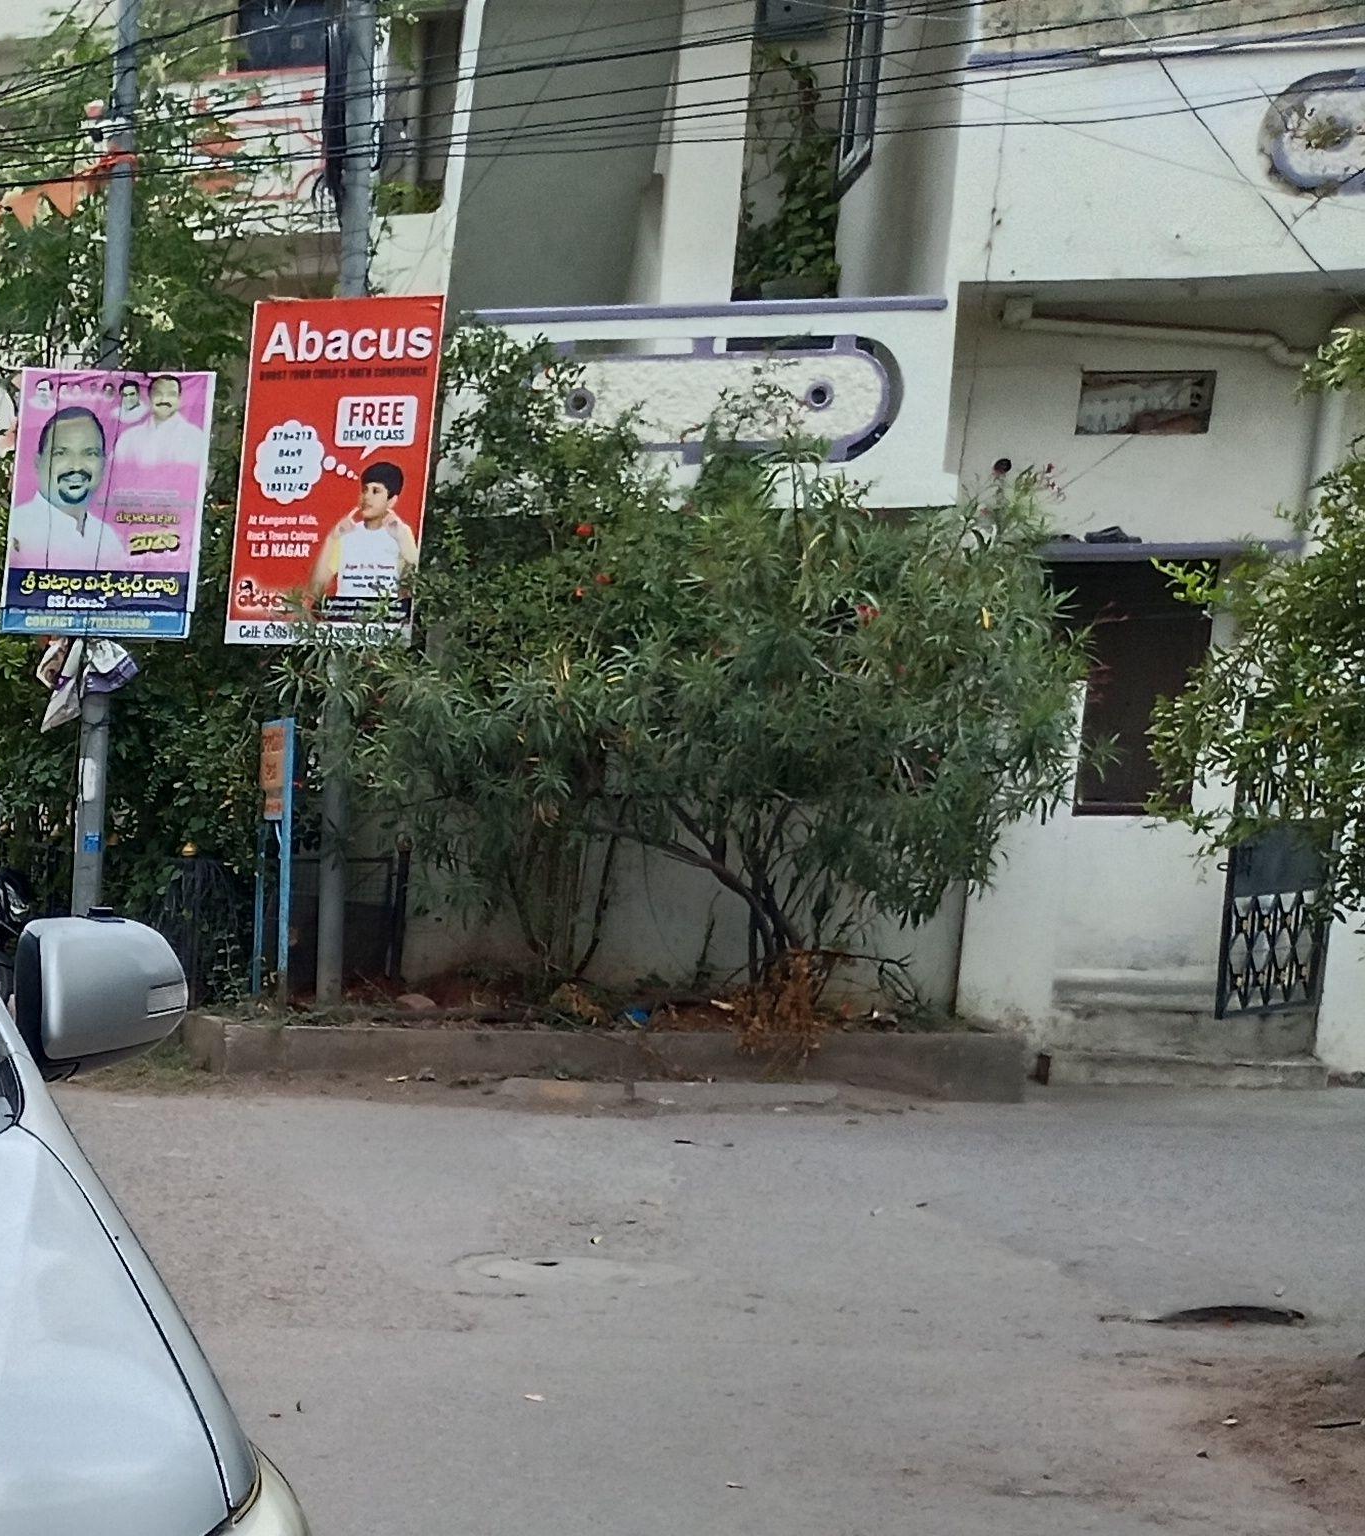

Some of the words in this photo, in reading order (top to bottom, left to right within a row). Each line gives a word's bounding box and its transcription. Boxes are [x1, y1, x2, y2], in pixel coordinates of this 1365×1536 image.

[261, 320, 433, 363] Abacus
[348, 402, 405, 426] FREE
[343, 430, 371, 441] DEMO
[374, 429, 405, 441] CLASS
[271, 544, 310, 557] NAGAR
[20, 571, 36, 594] శ్రీ
[24, 615, 75, 628] CONTACT
